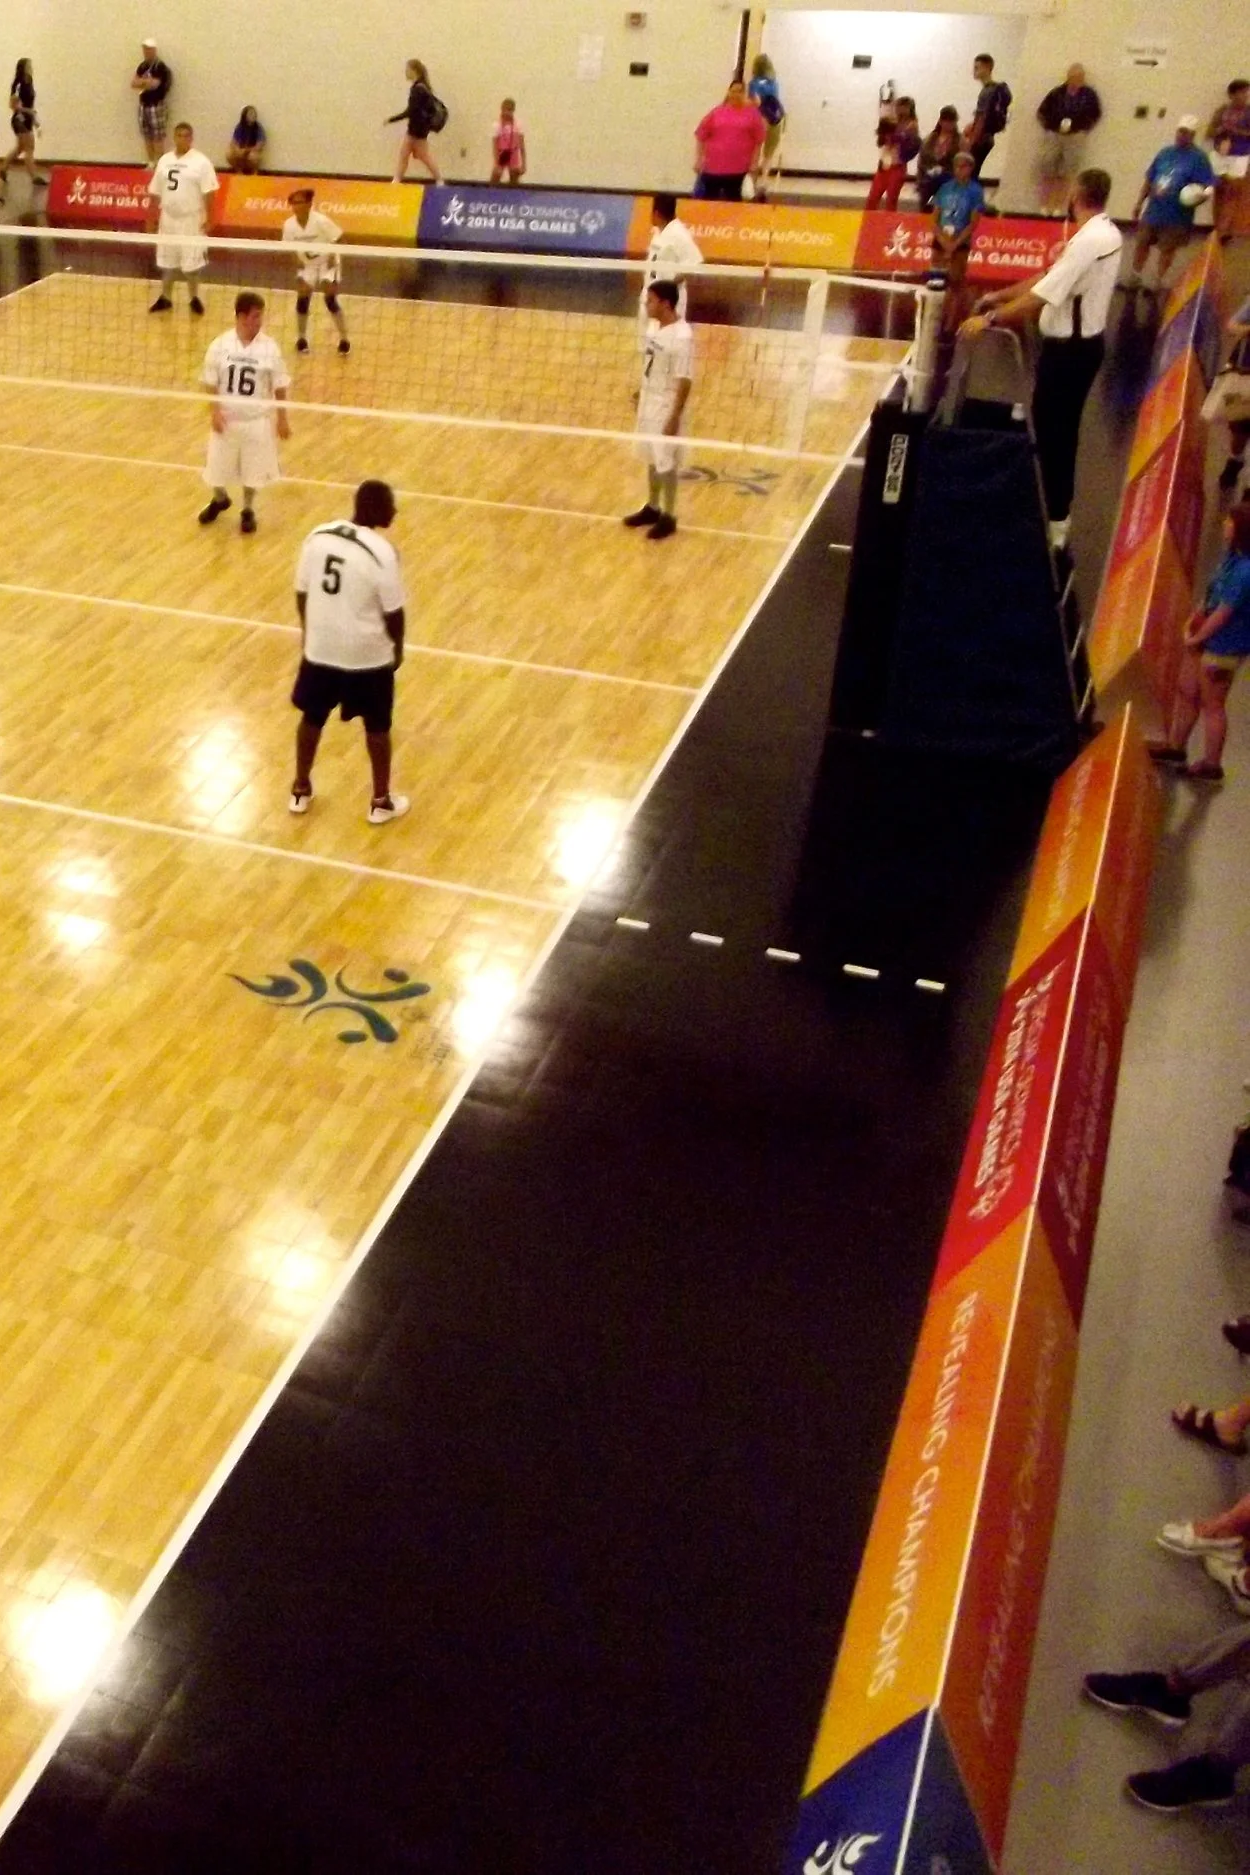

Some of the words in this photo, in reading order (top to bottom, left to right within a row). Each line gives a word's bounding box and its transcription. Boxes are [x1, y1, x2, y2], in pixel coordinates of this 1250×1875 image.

[91, 181, 129, 194] SPECIAL
[167, 169, 180, 191] 5
[88, 195, 113, 207] 2014
[117, 196, 139, 207] USA
[318, 202, 400, 218] CHAMPIONS
[468, 202, 514, 216] SPECIAL
[519, 204, 580, 220] OLYMPICS
[466, 215, 496, 229] 2014
[499, 216, 525, 230] USA
[528, 218, 577, 234] GAMES
[738, 226, 835, 246] CHAMPIONS
[976, 235, 1047, 250] OLYMPICS
[988, 251, 1044, 268] GAMES
[227, 363, 257, 396] 16
[321, 553, 346, 596] 5
[920, 1290, 980, 1462] REVEALING
[866, 1464, 940, 1698] CHAMPIONS
